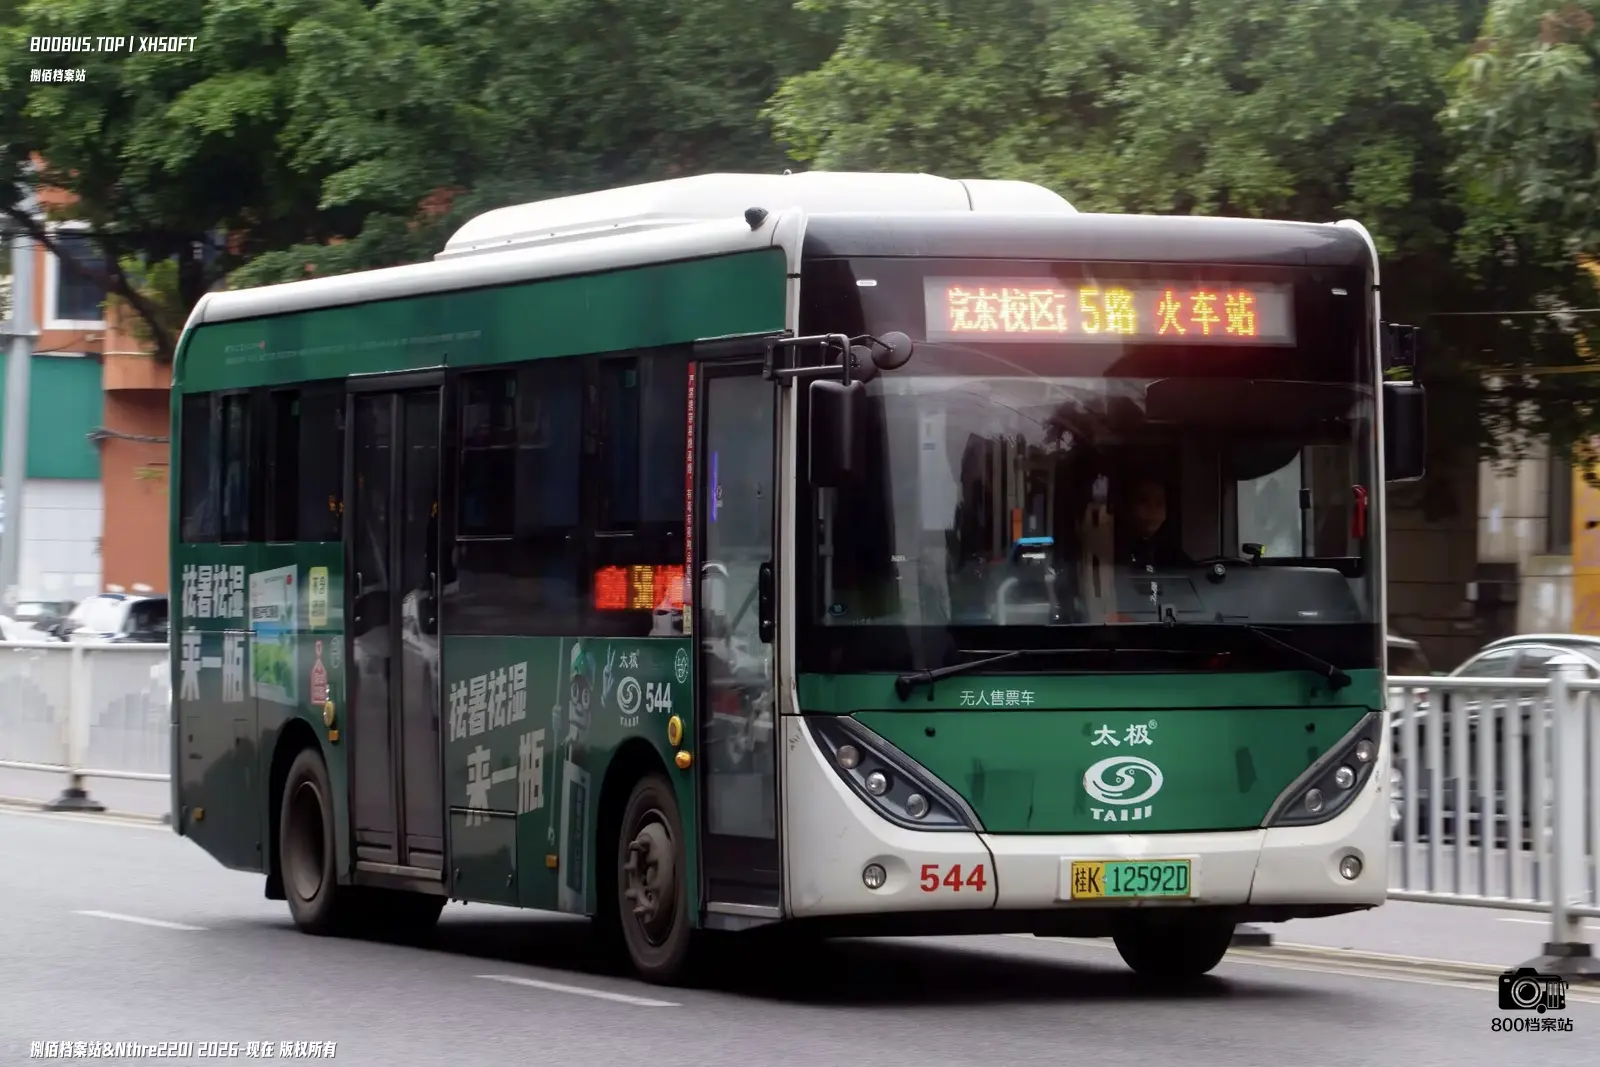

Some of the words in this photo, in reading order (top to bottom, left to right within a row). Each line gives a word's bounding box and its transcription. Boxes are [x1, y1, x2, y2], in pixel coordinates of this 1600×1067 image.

[1080, 288, 1136, 334] 5路
[1156, 289, 1256, 336] 火车站
[180, 627, 245, 702] 来一瓶
[449, 661, 528, 742] 祛暑祛湿
[645, 682, 673, 714] 544
[959, 689, 1036, 707] 无人售票车
[1090, 724, 1154, 747] 太极
[465, 728, 546, 828] 来一瓶
[1090, 805, 1153, 823] TAIJI
[920, 864, 987, 893] 544
[1075, 866, 1101, 894] 桂K
[1112, 865, 1189, 893] 12592D
